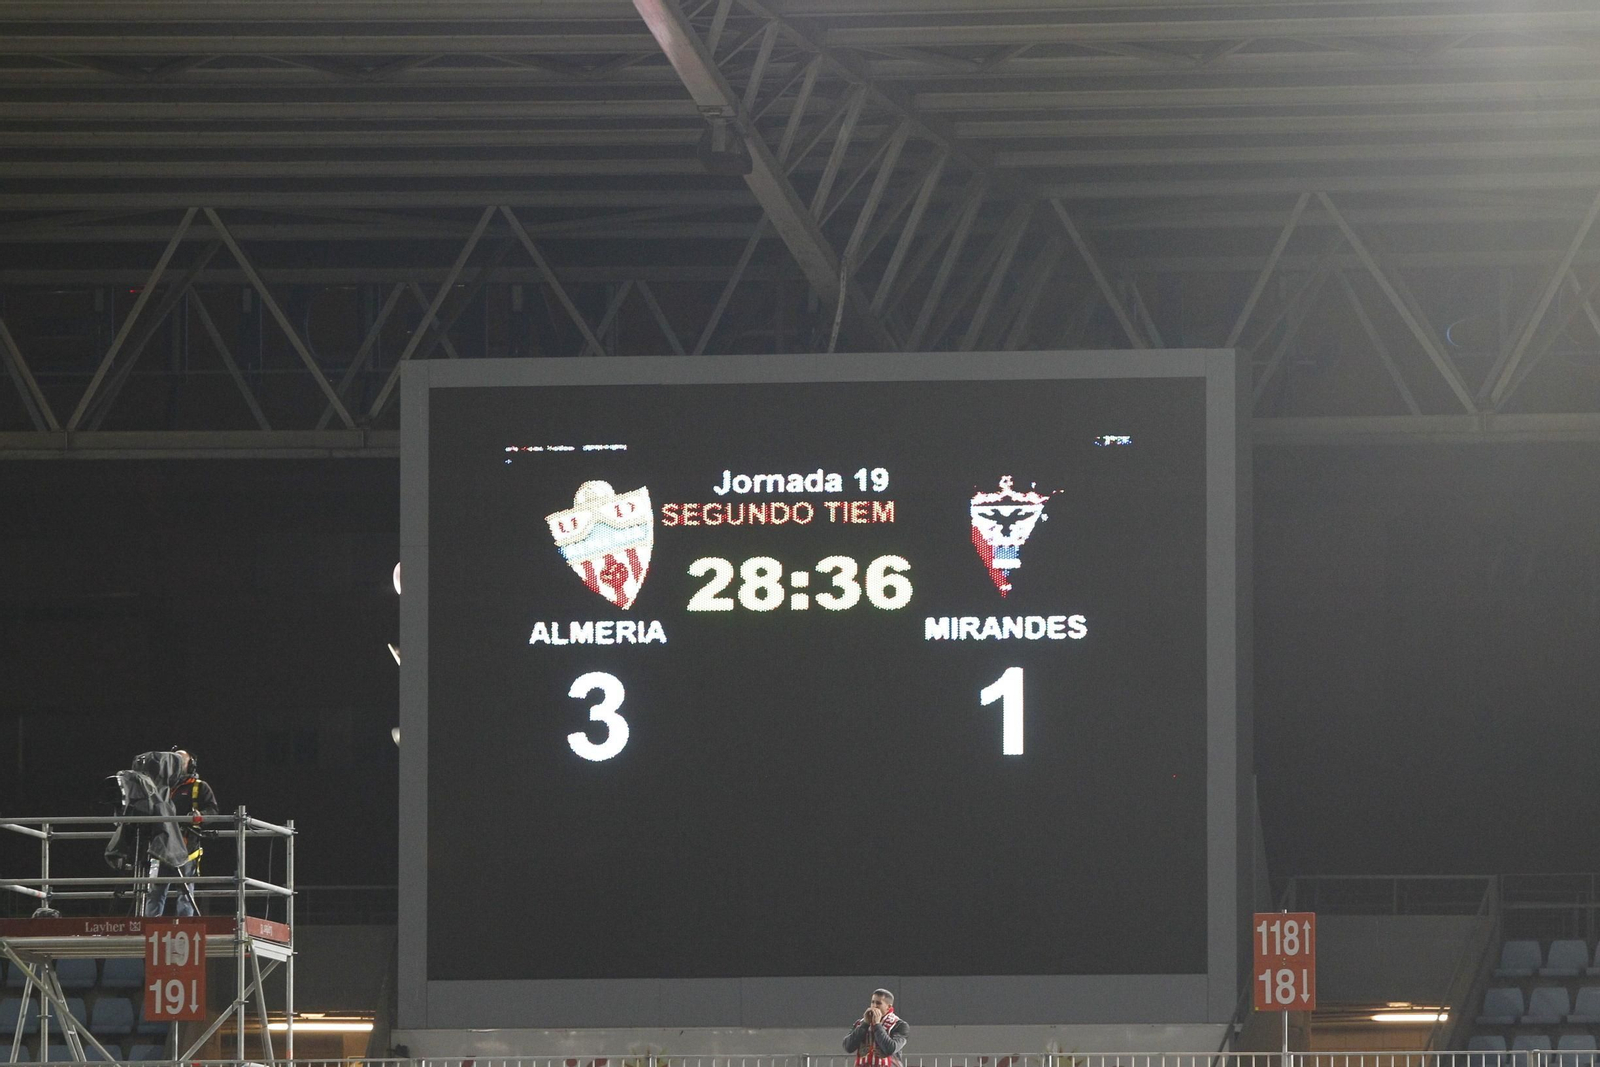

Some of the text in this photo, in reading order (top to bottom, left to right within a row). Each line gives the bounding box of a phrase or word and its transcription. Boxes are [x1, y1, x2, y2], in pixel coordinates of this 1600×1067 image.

[712, 467, 890, 496] Jornada 19
[661, 500, 815, 527] SEGUNDO
[823, 500, 895, 524] TIEM
[686, 554, 914, 613] 28:36
[528, 619, 668, 647] ALMERIA
[924, 614, 1088, 641] MIRANDES
[566, 670, 630, 763] 3
[979, 666, 1025, 756] 1
[85, 921, 125, 933] Layher
[1256, 919, 1300, 956] 118
[148, 931, 190, 967] 119
[149, 978, 185, 1015] 19
[1258, 968, 1296, 1005] 18
